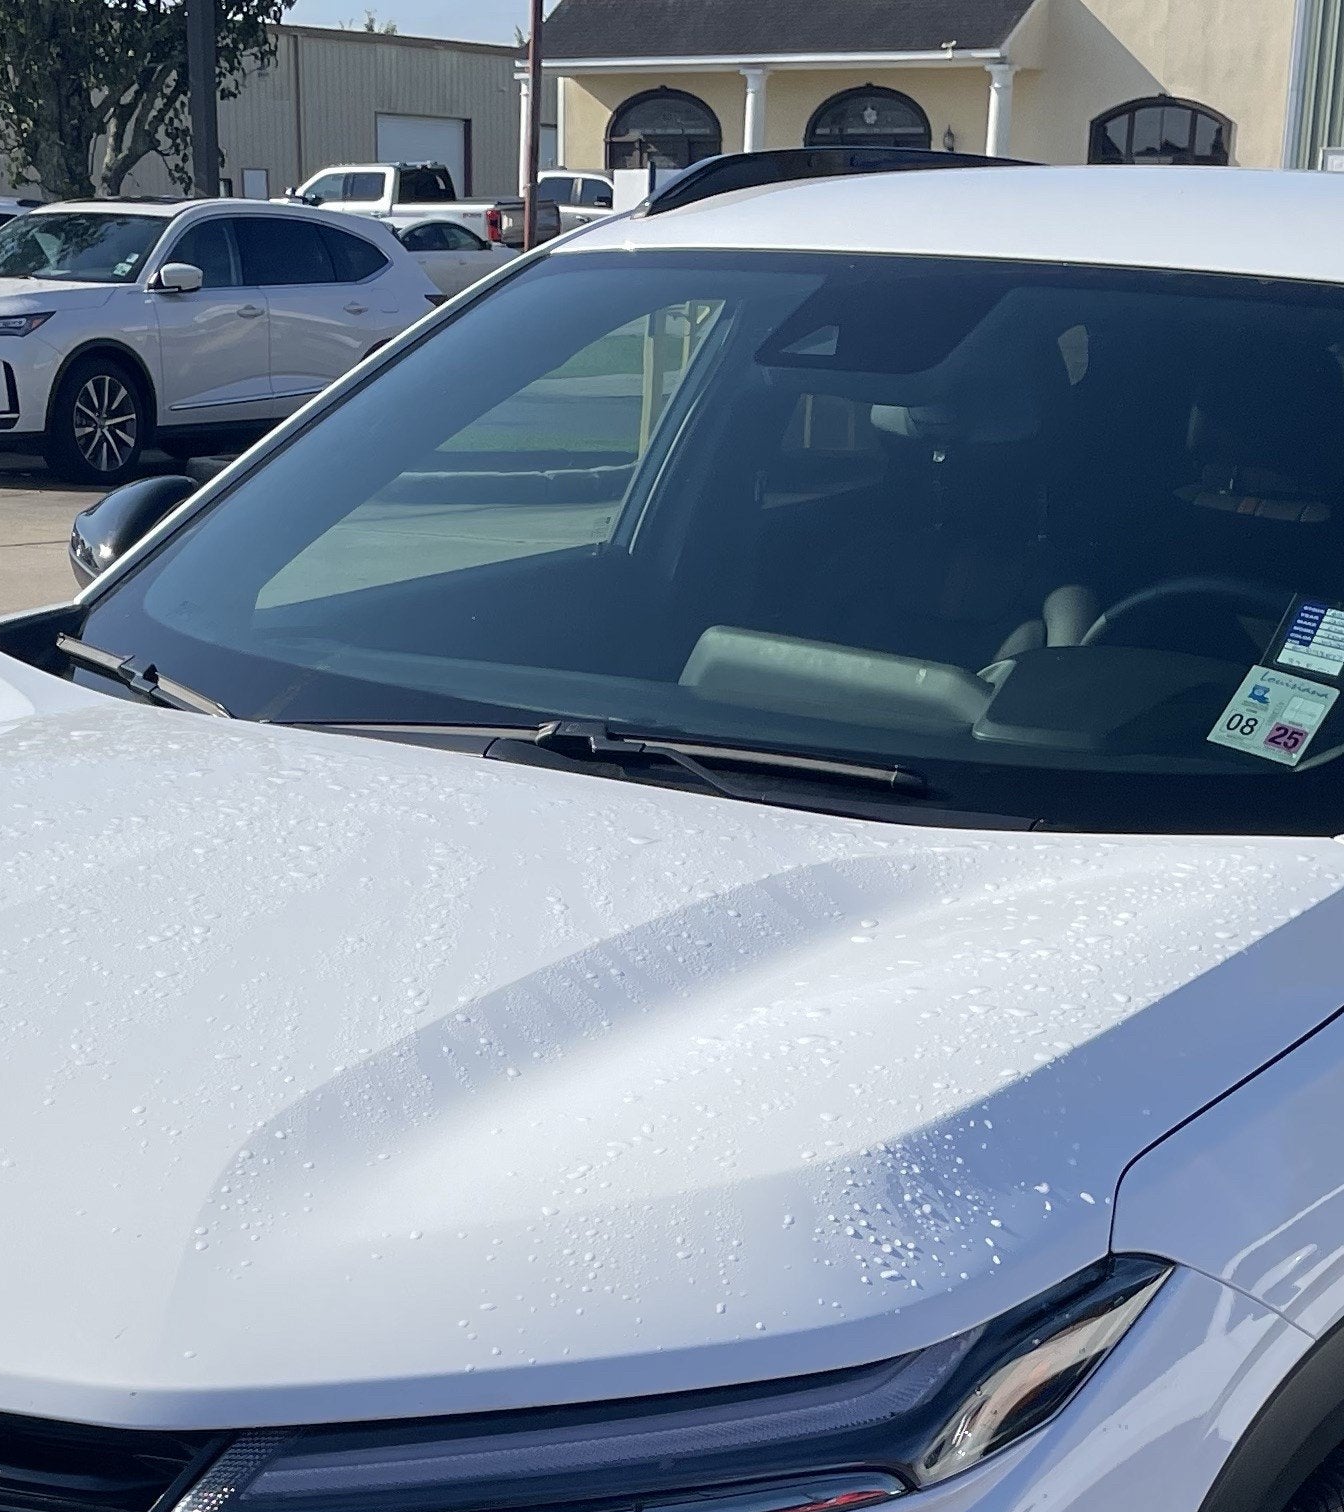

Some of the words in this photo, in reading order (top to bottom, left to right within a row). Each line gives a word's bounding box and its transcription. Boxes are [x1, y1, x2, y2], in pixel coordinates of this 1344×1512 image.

[1259, 670, 1330, 699] Louisiana
[1226, 713, 1259, 736] 08
[1268, 726, 1304, 749] 25
